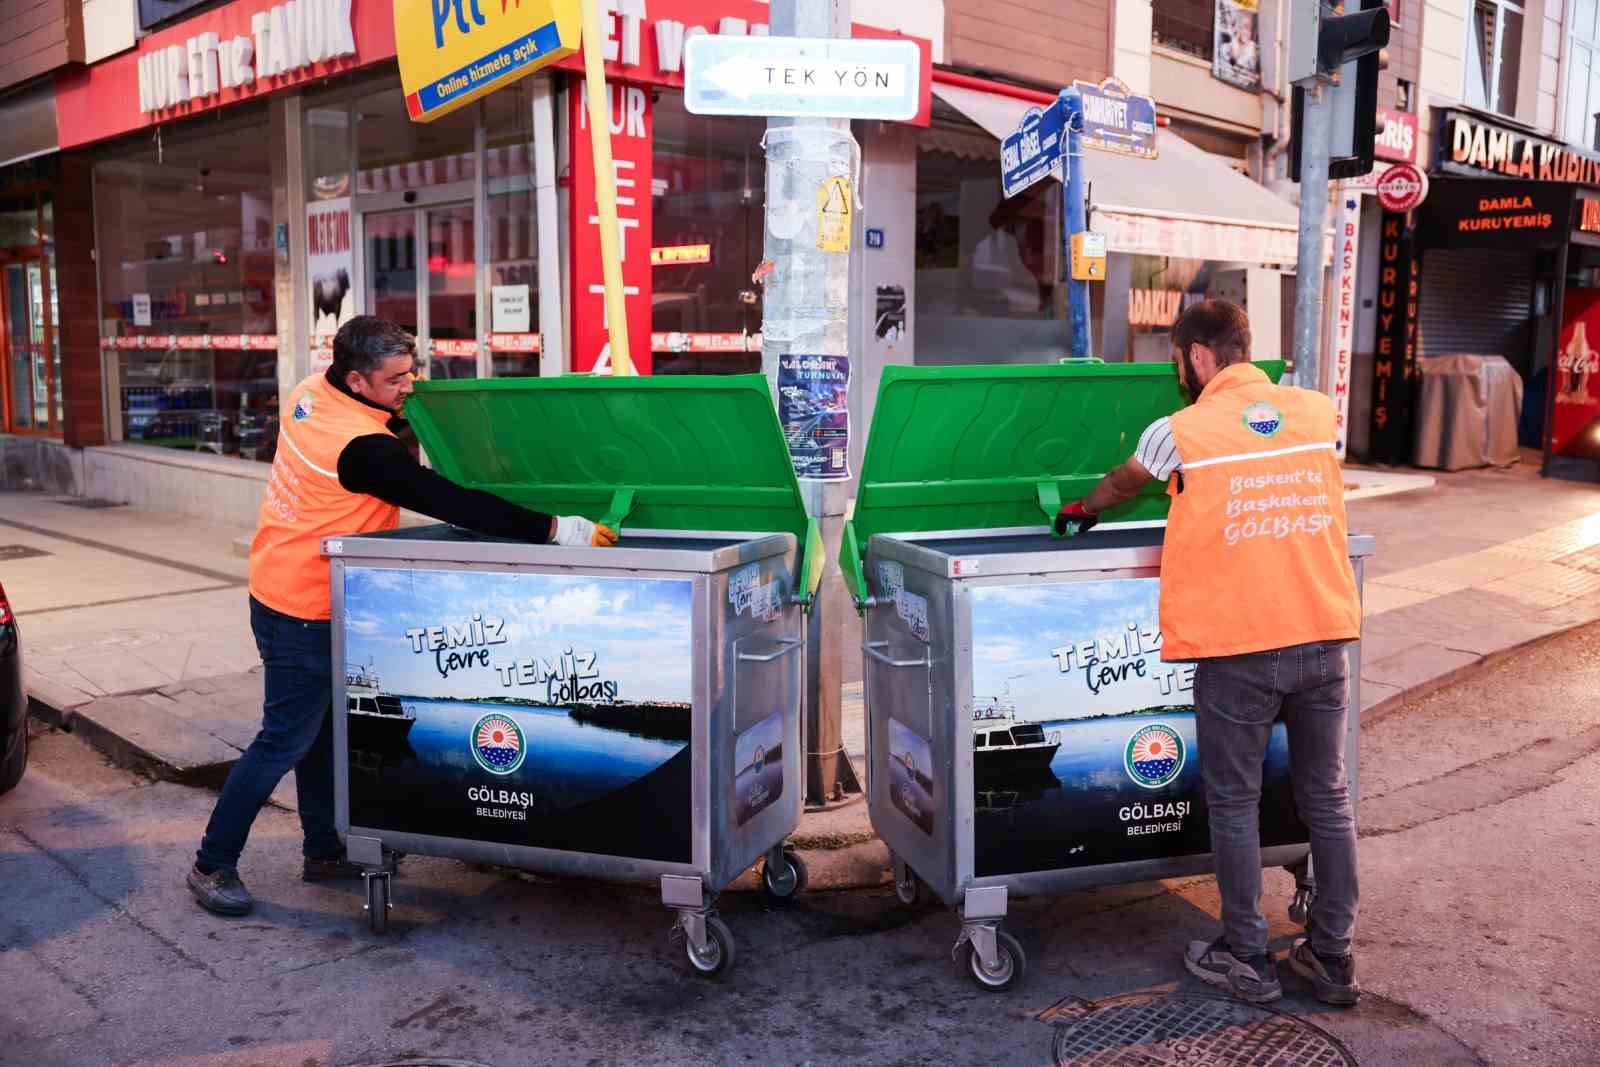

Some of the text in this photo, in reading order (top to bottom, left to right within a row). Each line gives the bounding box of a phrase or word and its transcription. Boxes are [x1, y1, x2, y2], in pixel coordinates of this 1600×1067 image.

[436, 38, 538, 98] Online hizmete açık
[764, 65, 889, 89] TEK YÖN
[1453, 118, 1535, 179] DAMLA
[1479, 195, 1533, 212] DAMLA
[1458, 211, 1553, 232] KURUYEMİŞ
[405, 612, 508, 653] TEMİZ
[436, 643, 489, 678] Çevre
[495, 646, 600, 687] TEMİZ
[546, 672, 618, 705] Gölbaşı
[1085, 656, 1147, 695] Çevre
[467, 785, 534, 809] GÖLBAŞI
[1118, 801, 1190, 821] GÖLBAŞI
[476, 807, 527, 821] BELEDİYESİ
[1127, 820, 1182, 836] BELEDİYESİ
